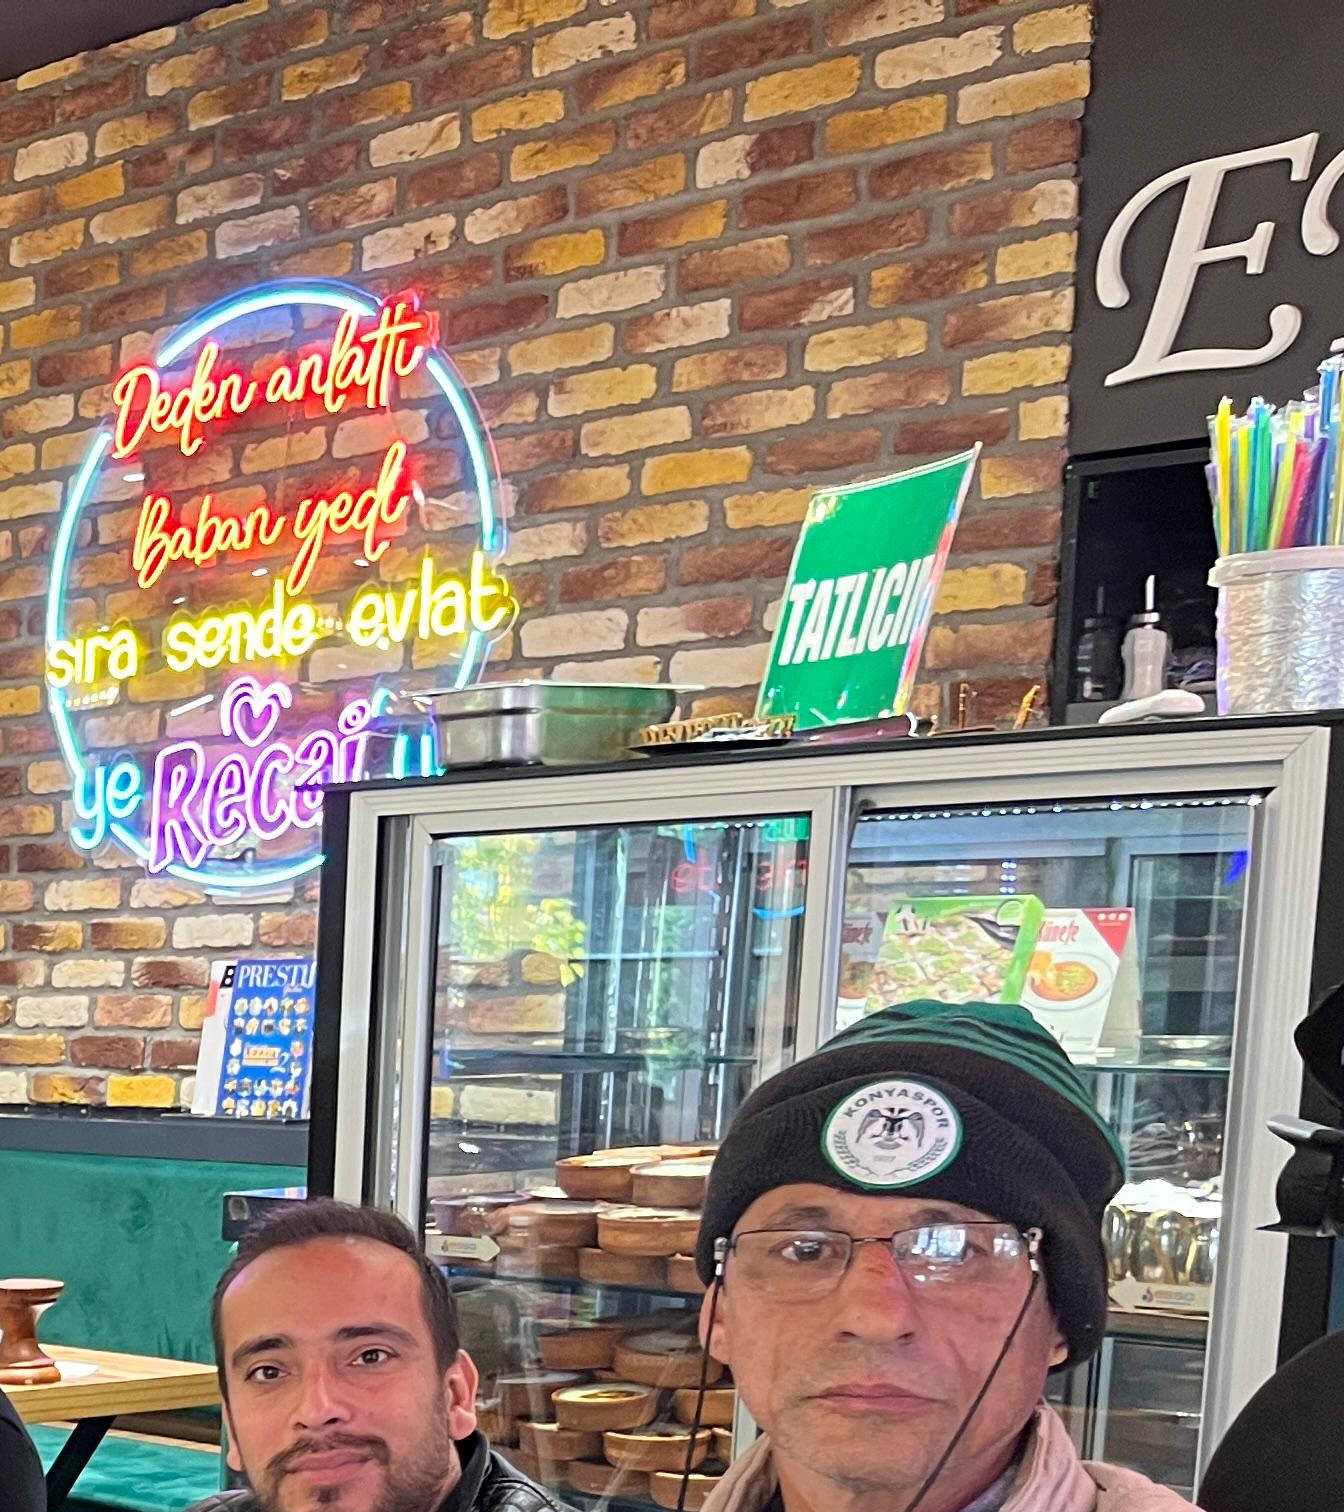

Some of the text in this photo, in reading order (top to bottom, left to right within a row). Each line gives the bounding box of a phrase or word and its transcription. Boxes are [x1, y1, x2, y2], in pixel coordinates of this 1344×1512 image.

[132, 494, 286, 590] Baban
[166, 580, 317, 672] sende
[348, 552, 511, 649] evlat
[69, 762, 144, 850] ye
[842, 1087, 950, 1129] KONYASPOR
